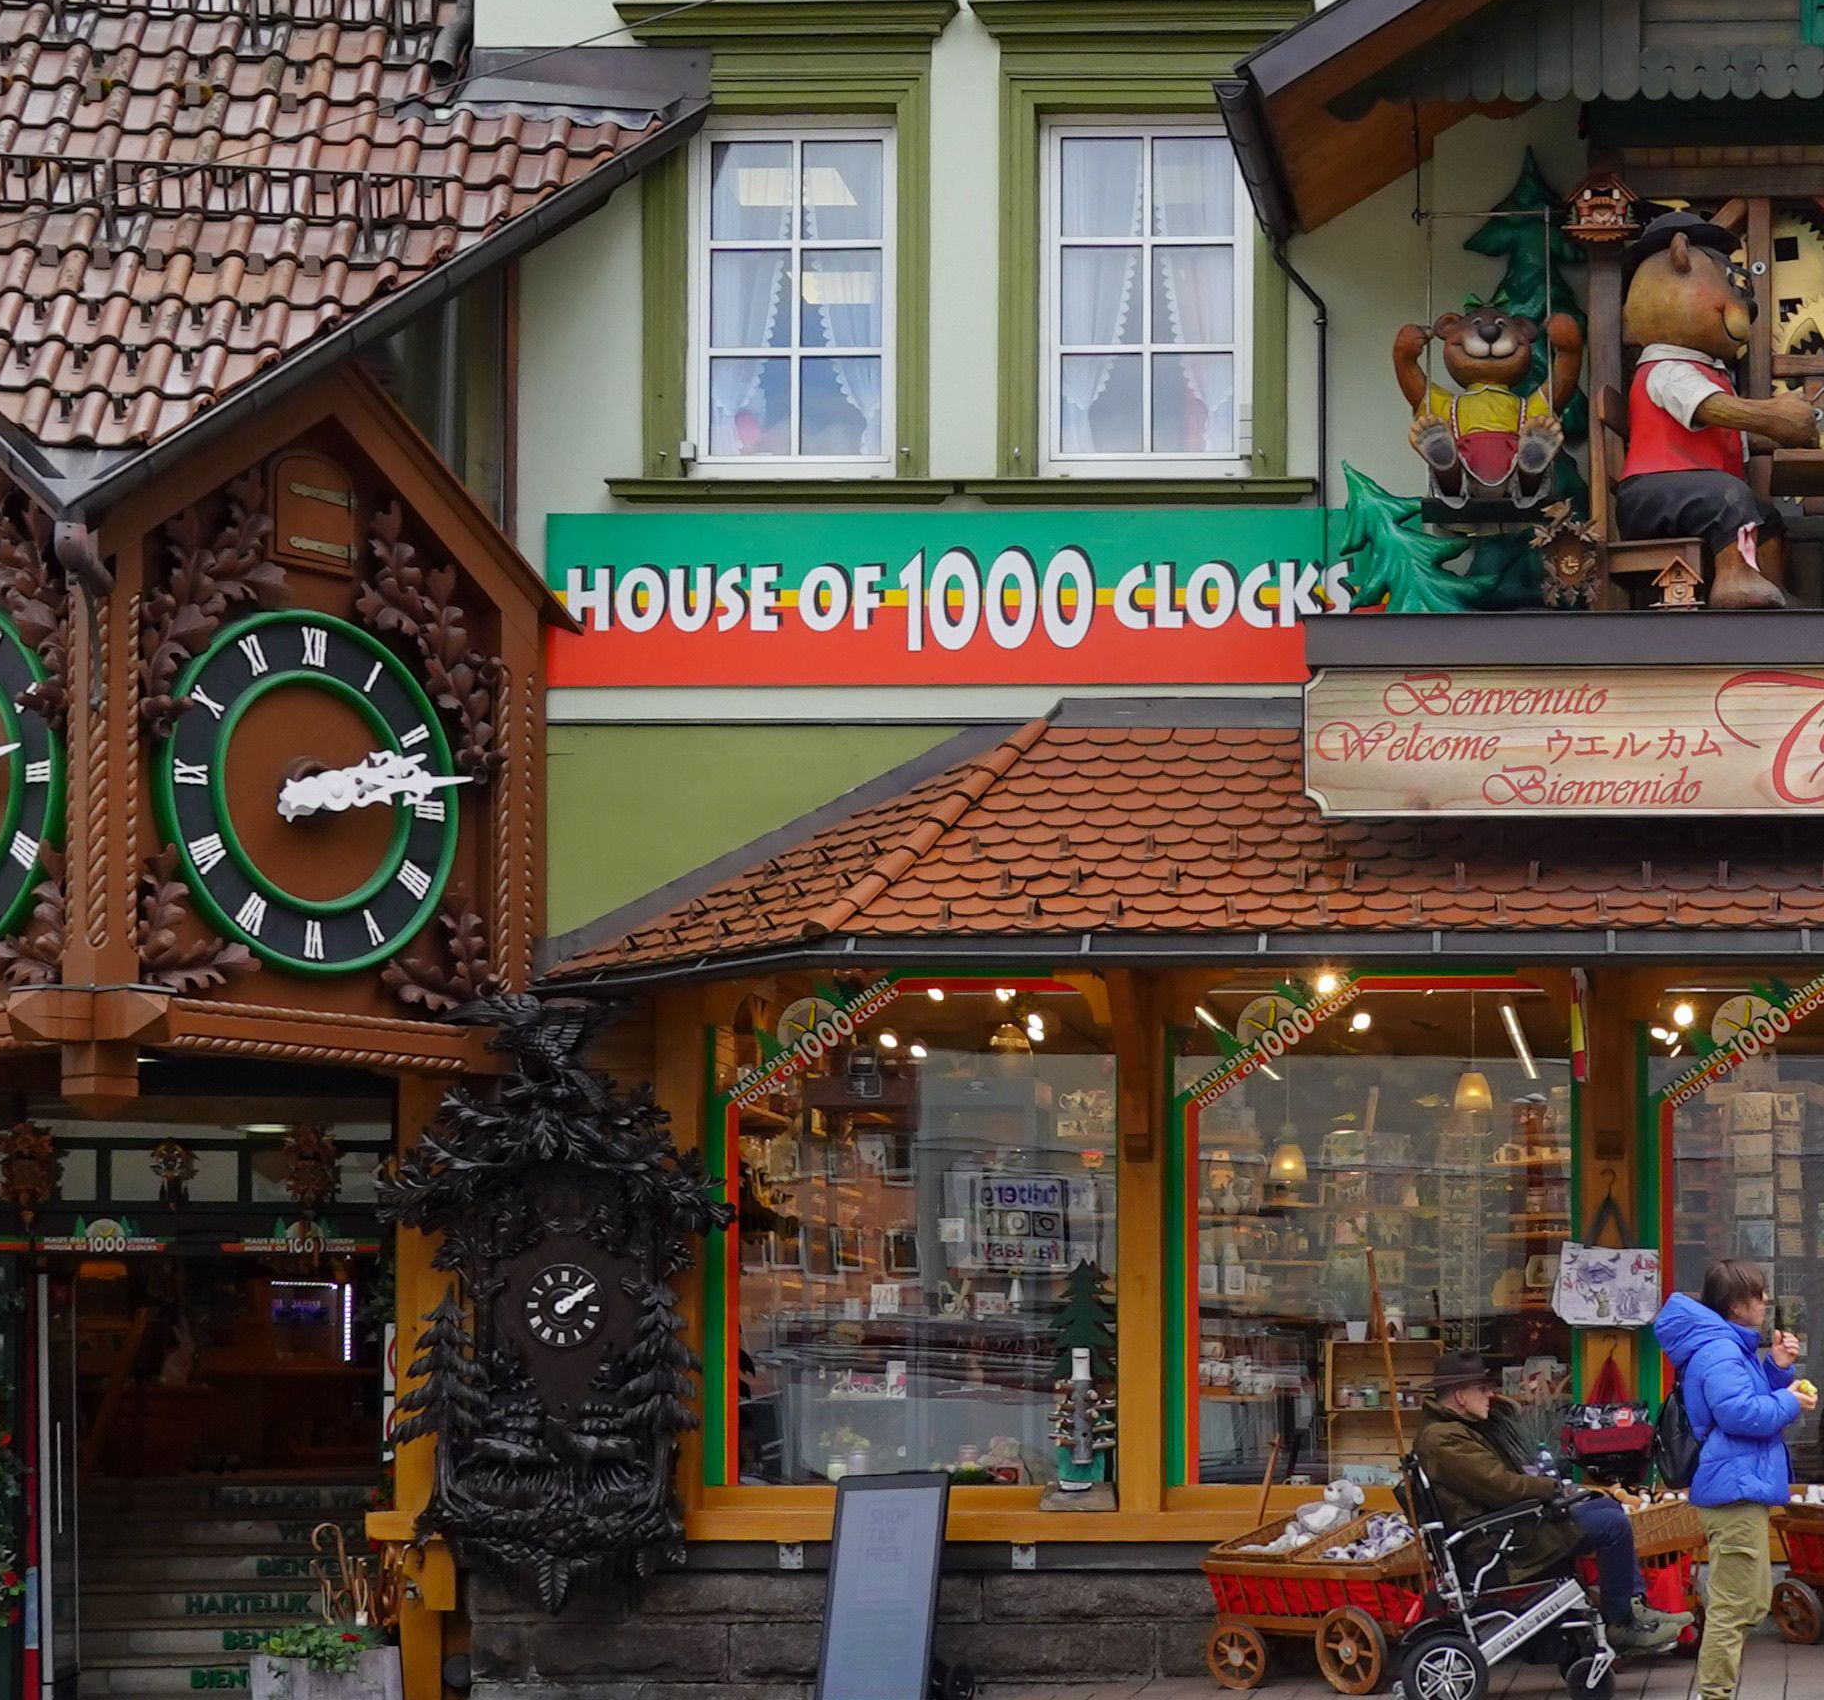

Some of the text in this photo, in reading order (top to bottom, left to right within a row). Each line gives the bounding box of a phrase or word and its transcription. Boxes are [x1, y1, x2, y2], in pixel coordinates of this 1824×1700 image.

[567, 546, 1356, 652] HOUSE OF 1000 CLOCKS
[1383, 672, 1609, 717] Benvenuto
[1314, 721, 1501, 763] Welcome
[1545, 727, 1724, 765] ウエルカム
[1482, 764, 1704, 805] Bienvenido
[729, 977, 890, 1098] HAUS DER 1000 UHREN
[736, 987, 900, 1110] HOUSE OF CLOCKS
[1189, 1068, 1225, 1097] HAUS
[1226, 1048, 1252, 1071] DER
[1254, 1007, 1315, 1064] 1000
[1197, 985, 1361, 1108] HOUSE OF CLOCKS
[1662, 1067, 1698, 1097] HAUS
[1700, 1048, 1726, 1071] DER
[1729, 1005, 1791, 1063] 1000
[1671, 1074, 1713, 1109] HOUSE
[1716, 1058, 1735, 1075] OF
[88, 1236, 126, 1252] 1000
